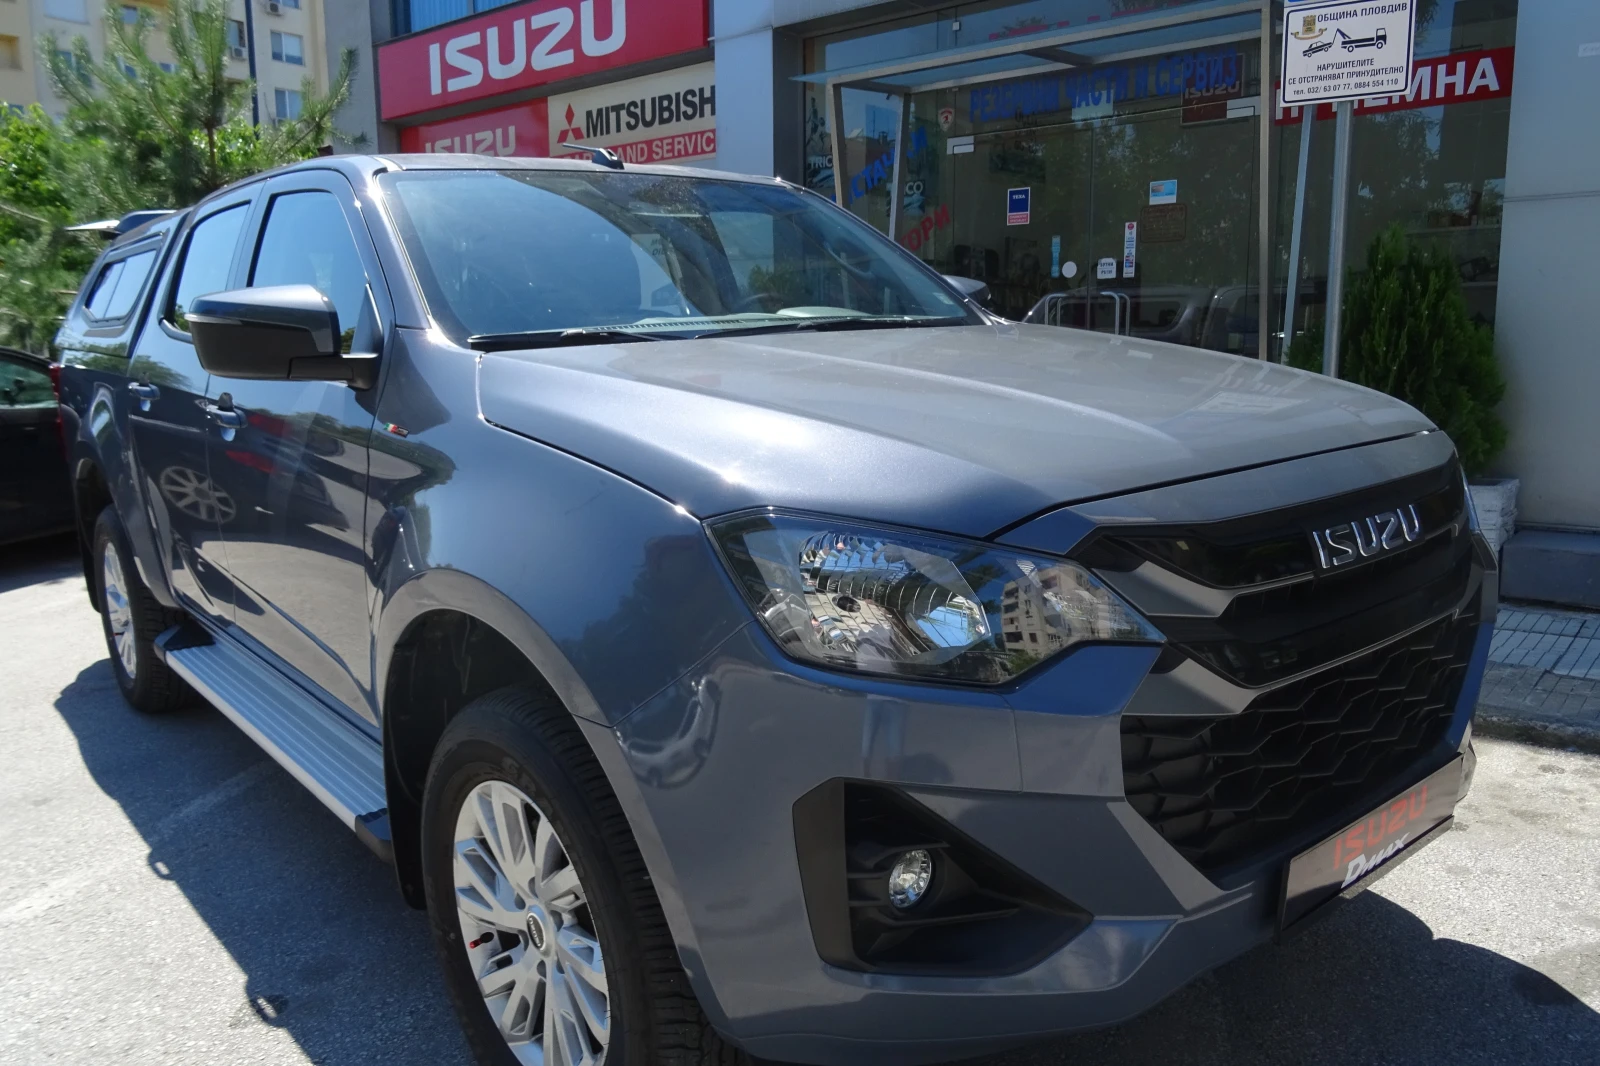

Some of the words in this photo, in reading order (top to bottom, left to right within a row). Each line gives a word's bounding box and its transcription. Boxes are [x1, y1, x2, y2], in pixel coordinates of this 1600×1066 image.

[1317, 9, 1358, 23] ОБЩИНА
[1361, 2, 1408, 17] ПЛОВДИВ
[429, 0, 627, 96] ISUZU
[1065, 66, 1129, 109] ЧАСТИ
[1135, 63, 1149, 99] И
[1155, 48, 1237, 96] СЕРВИЗ
[1288, 77, 1297, 86] СЕ
[1298, 71, 1345, 85] ОТСТРАНЯВАТ
[1346, 65, 1404, 80] ПРИНУДИТЕЛНО
[1317, 58, 1375, 72] НАРУШИТЕЛИТЕ
[1333, 84, 1341, 92] 07
[585, 85, 716, 138] MITSUBISH
[617, 144, 650, 163] AND
[652, 132, 715, 160] SERVIC
[808, 155, 833, 168] TRIC
[1312, 503, 1422, 569] ISUZU
[1333, 785, 1428, 871] ISUZU
